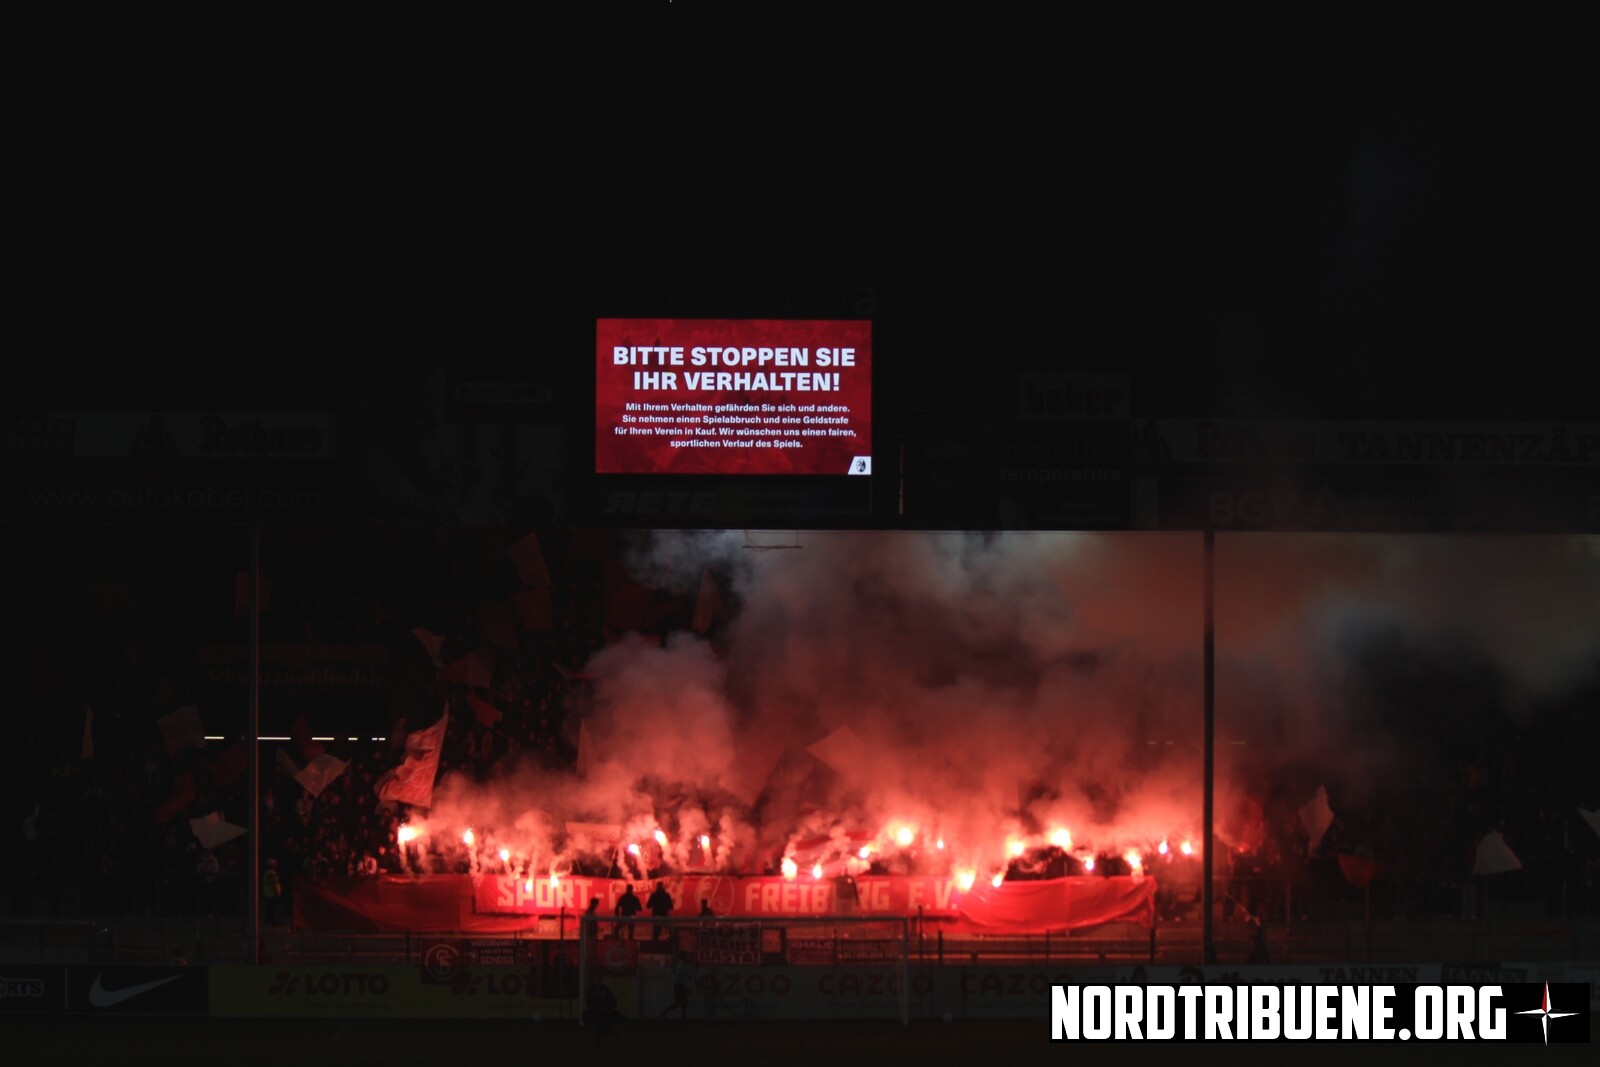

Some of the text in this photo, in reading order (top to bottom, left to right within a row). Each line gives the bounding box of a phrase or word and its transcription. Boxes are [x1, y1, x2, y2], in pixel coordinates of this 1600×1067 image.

[614, 347, 855, 366] BITTE STOPPEN SIE
[634, 372, 840, 391] IHR VERHALTEN!
[626, 403, 850, 414] Mit Ihrem Verhalten gefährden Sie sich und andere.
[622, 415, 849, 425] Sie nehmen einen Spielabbruch und eine Geldstrafe
[615, 427, 627, 435] für
[629, 427, 653, 435] Ihren
[655, 427, 683, 435] Verein
[695, 427, 717, 435] Kauf.
[736, 428, 781, 436] wünschen
[802, 428, 827, 436] einen
[828, 428, 857, 438] fairen,
[670, 439, 803, 449] sportlichen Verlauf des Spiels.
[1000, 468, 1122, 485] temperature
[29, 486, 321, 510] www.autokabel.com
[303, 975, 387, 996] LOTTO
